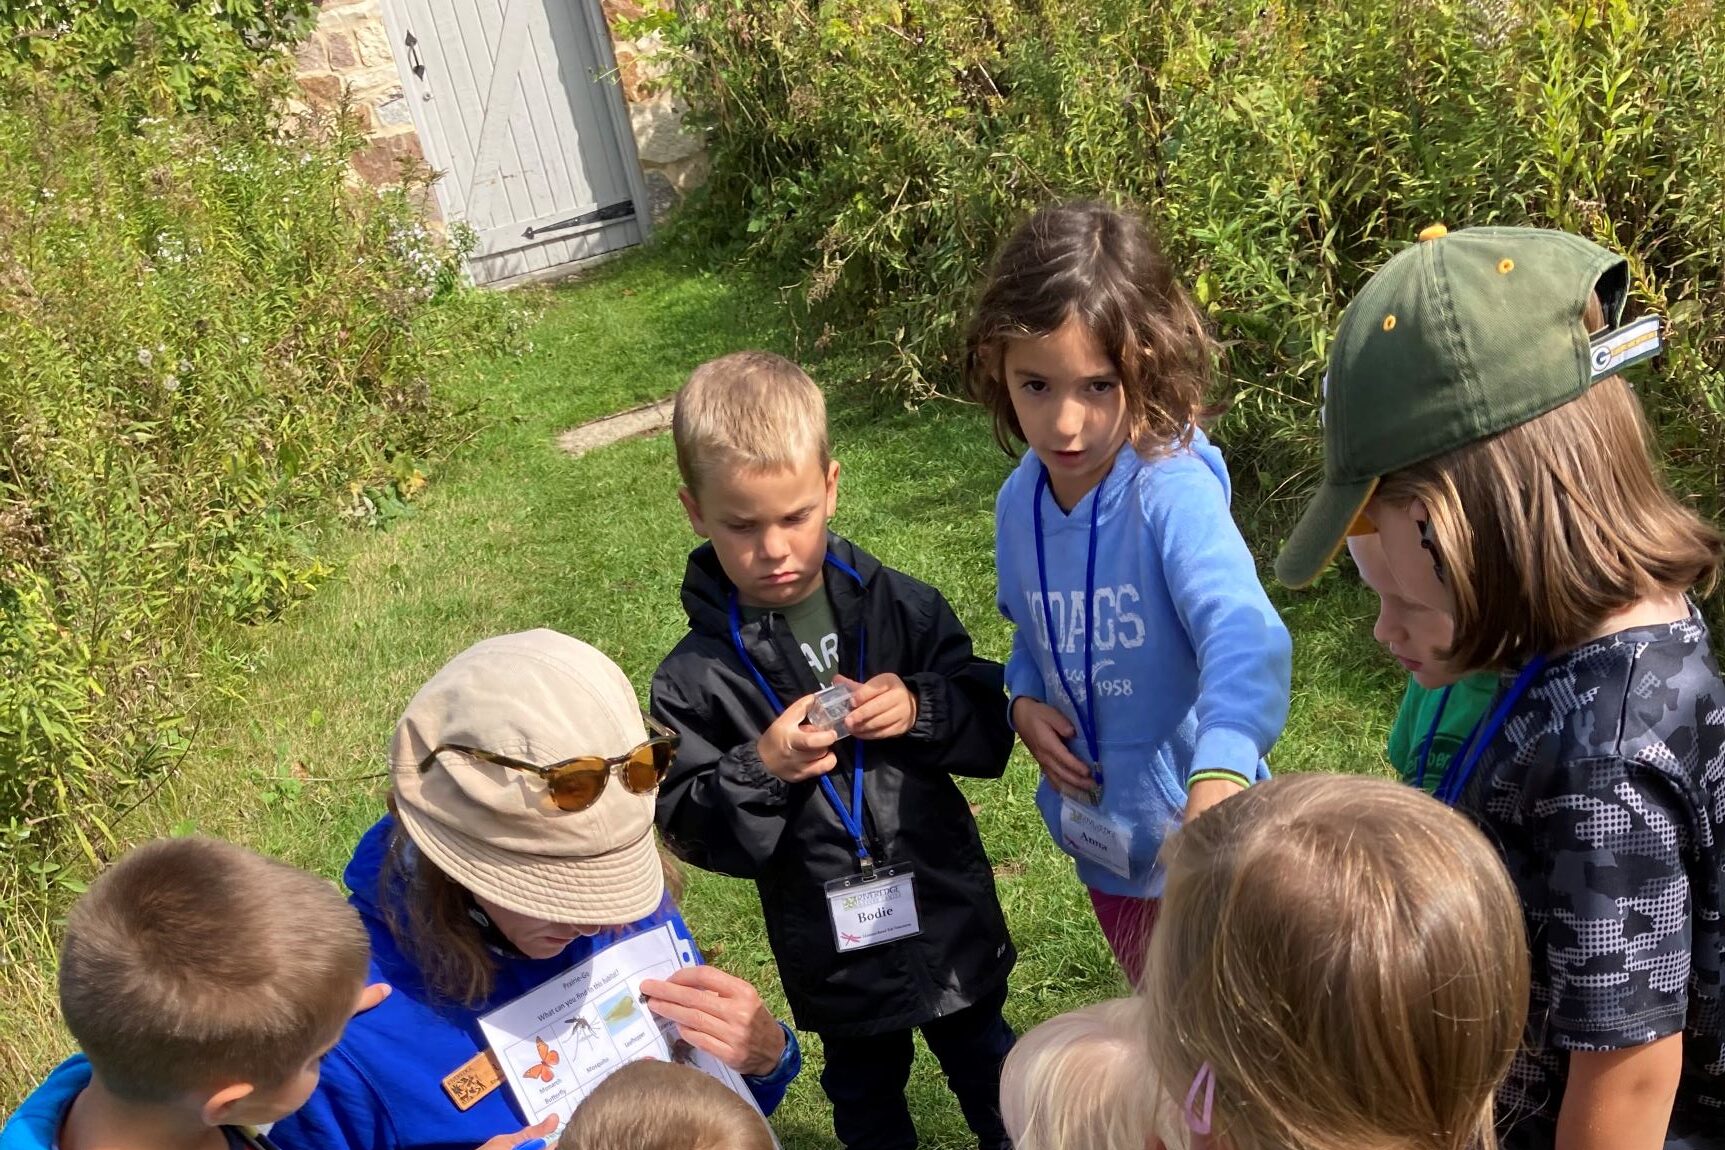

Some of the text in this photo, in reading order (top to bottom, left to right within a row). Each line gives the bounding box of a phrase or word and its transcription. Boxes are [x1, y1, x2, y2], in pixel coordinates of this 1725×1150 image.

[1095, 678, 1134, 697] 1958
[857, 906, 893, 923] Bodie
[537, 1007, 557, 1022] What
[564, 997, 577, 1008] you
